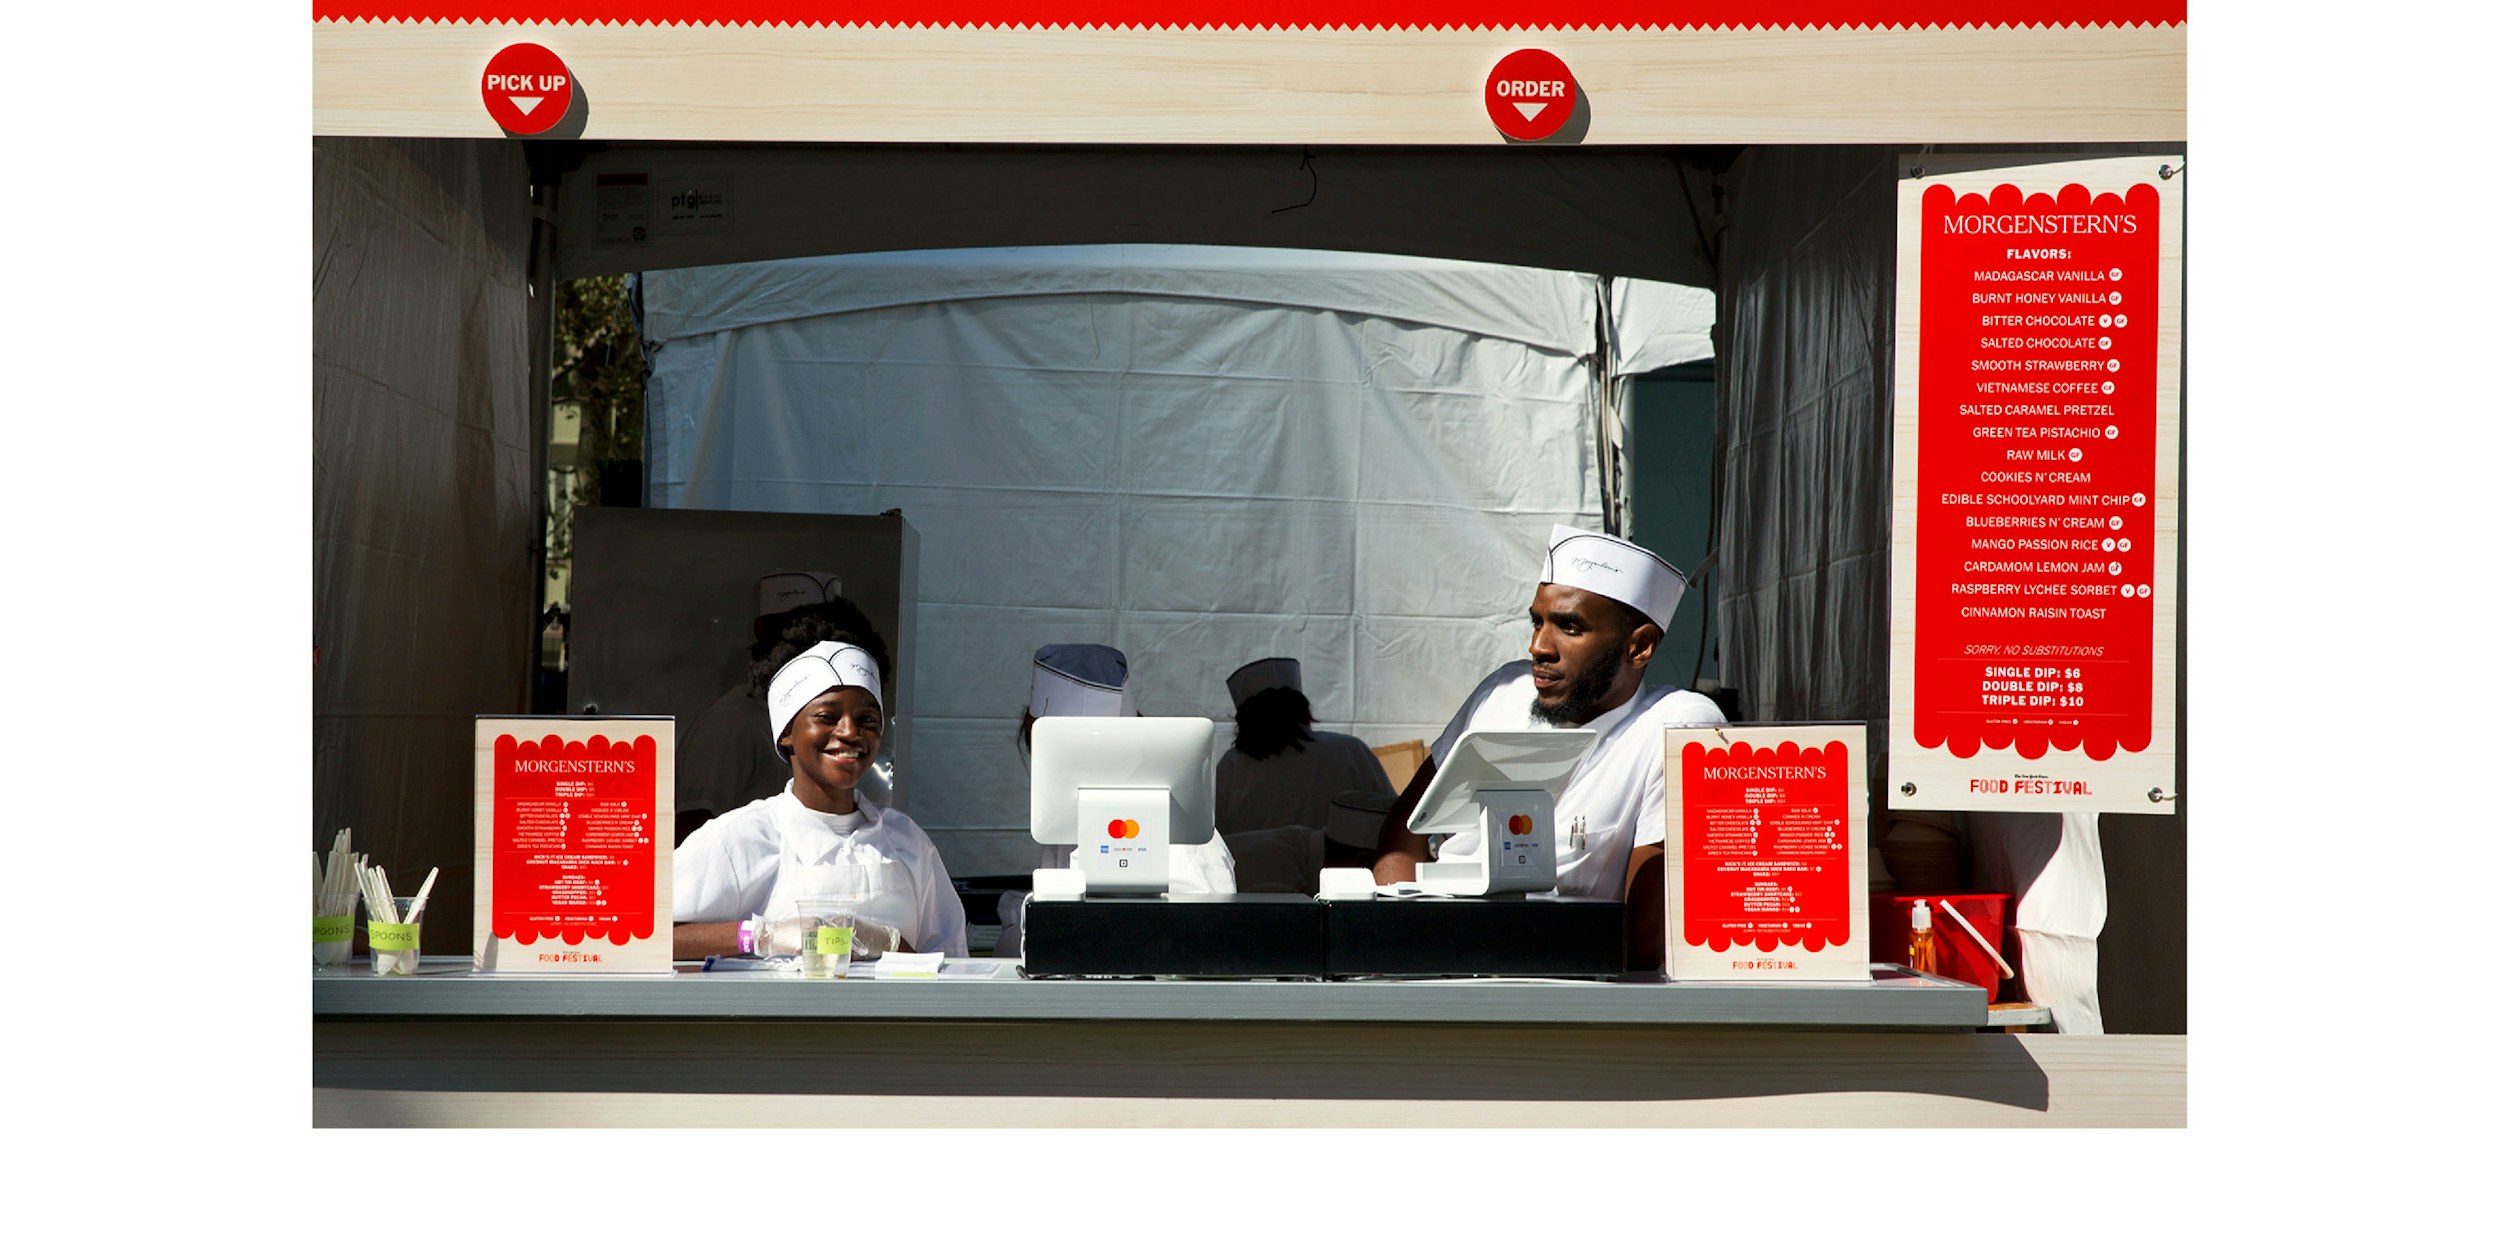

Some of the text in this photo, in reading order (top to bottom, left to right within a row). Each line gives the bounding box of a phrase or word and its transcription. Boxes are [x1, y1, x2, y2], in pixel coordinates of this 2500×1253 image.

[488, 75, 566, 91] PICK UP
[1497, 80, 1565, 97] ORDER
[1944, 215, 2136, 234] MORGENSTERN'S
[2007, 249, 2071, 259] FLAVORS:
[1974, 271, 2054, 281] MADAGASCAR
[2057, 271, 2105, 281] VANILLA
[1973, 293, 2012, 303] BURNT
[2016, 293, 2056, 303] HONEY
[2058, 293, 2106, 303] VANILLA
[1982, 316, 2023, 326] BITTER
[2026, 316, 2095, 326] CHOCOLATE
[1981, 338, 2023, 348] SALTED
[2026, 338, 2095, 348] CHOCOLATE
[1971, 360, 2021, 371] SMOOTH
[2025, 360, 2104, 371] STRAWBERRY
[1977, 382, 2049, 393] VIETNAMESE
[2053, 383, 2098, 393] COFFEE
[1960, 405, 2114, 415] SALTED CARAMEL PRETZEL
[1973, 427, 2012, 438] GREEN
[2015, 427, 2037, 438] TEA
[2040, 427, 2100, 438] PISTACHIO
[2007, 450, 2034, 460] RAW
[2037, 450, 2065, 460] MILK
[1981, 472, 2032, 483] COOKIES
[2049, 472, 2090, 483] CREAM
[1942, 494, 1983, 504] EDIBLE
[1987, 494, 2065, 505] SCHOOLYARD
[2069, 495, 2099, 505] MINT
[2101, 495, 2130, 505] CHIP
[1966, 516, 2046, 528] BLUEBERRIES
[2063, 518, 2104, 528] CREAM
[1972, 539, 2015, 549] MANGO
[2019, 539, 2068, 550] PASSION
[2072, 540, 2098, 550] RICE
[1964, 561, 2033, 572] CARDAMOM
[2037, 562, 2078, 572] LEMON
[2082, 563, 2104, 573] JAM
[1952, 584, 2021, 594] RASPBERRY
[2024, 584, 2066, 595] LYCHEE
[2071, 585, 2117, 595] SORBET
[1961, 607, 2106, 619] CINNAMON RAISIN TOAST
[2004, 645, 2020, 655] NO
[2022, 645, 2104, 656] SUBSTITUTIONS
[1985, 666, 2080, 679] SINGLE DIP: $6
[1983, 681, 2083, 692] DOUBLE DIP: $8
[1982, 695, 2084, 707] TRIPLE DIP: $10
[516, 760, 635, 772] MORGENSTERN'S
[1704, 767, 1826, 779] MORGENSTERN'S
[1971, 780, 2092, 795] FOOD FESTIVAL
[371, 930, 412, 941] SPOONS
